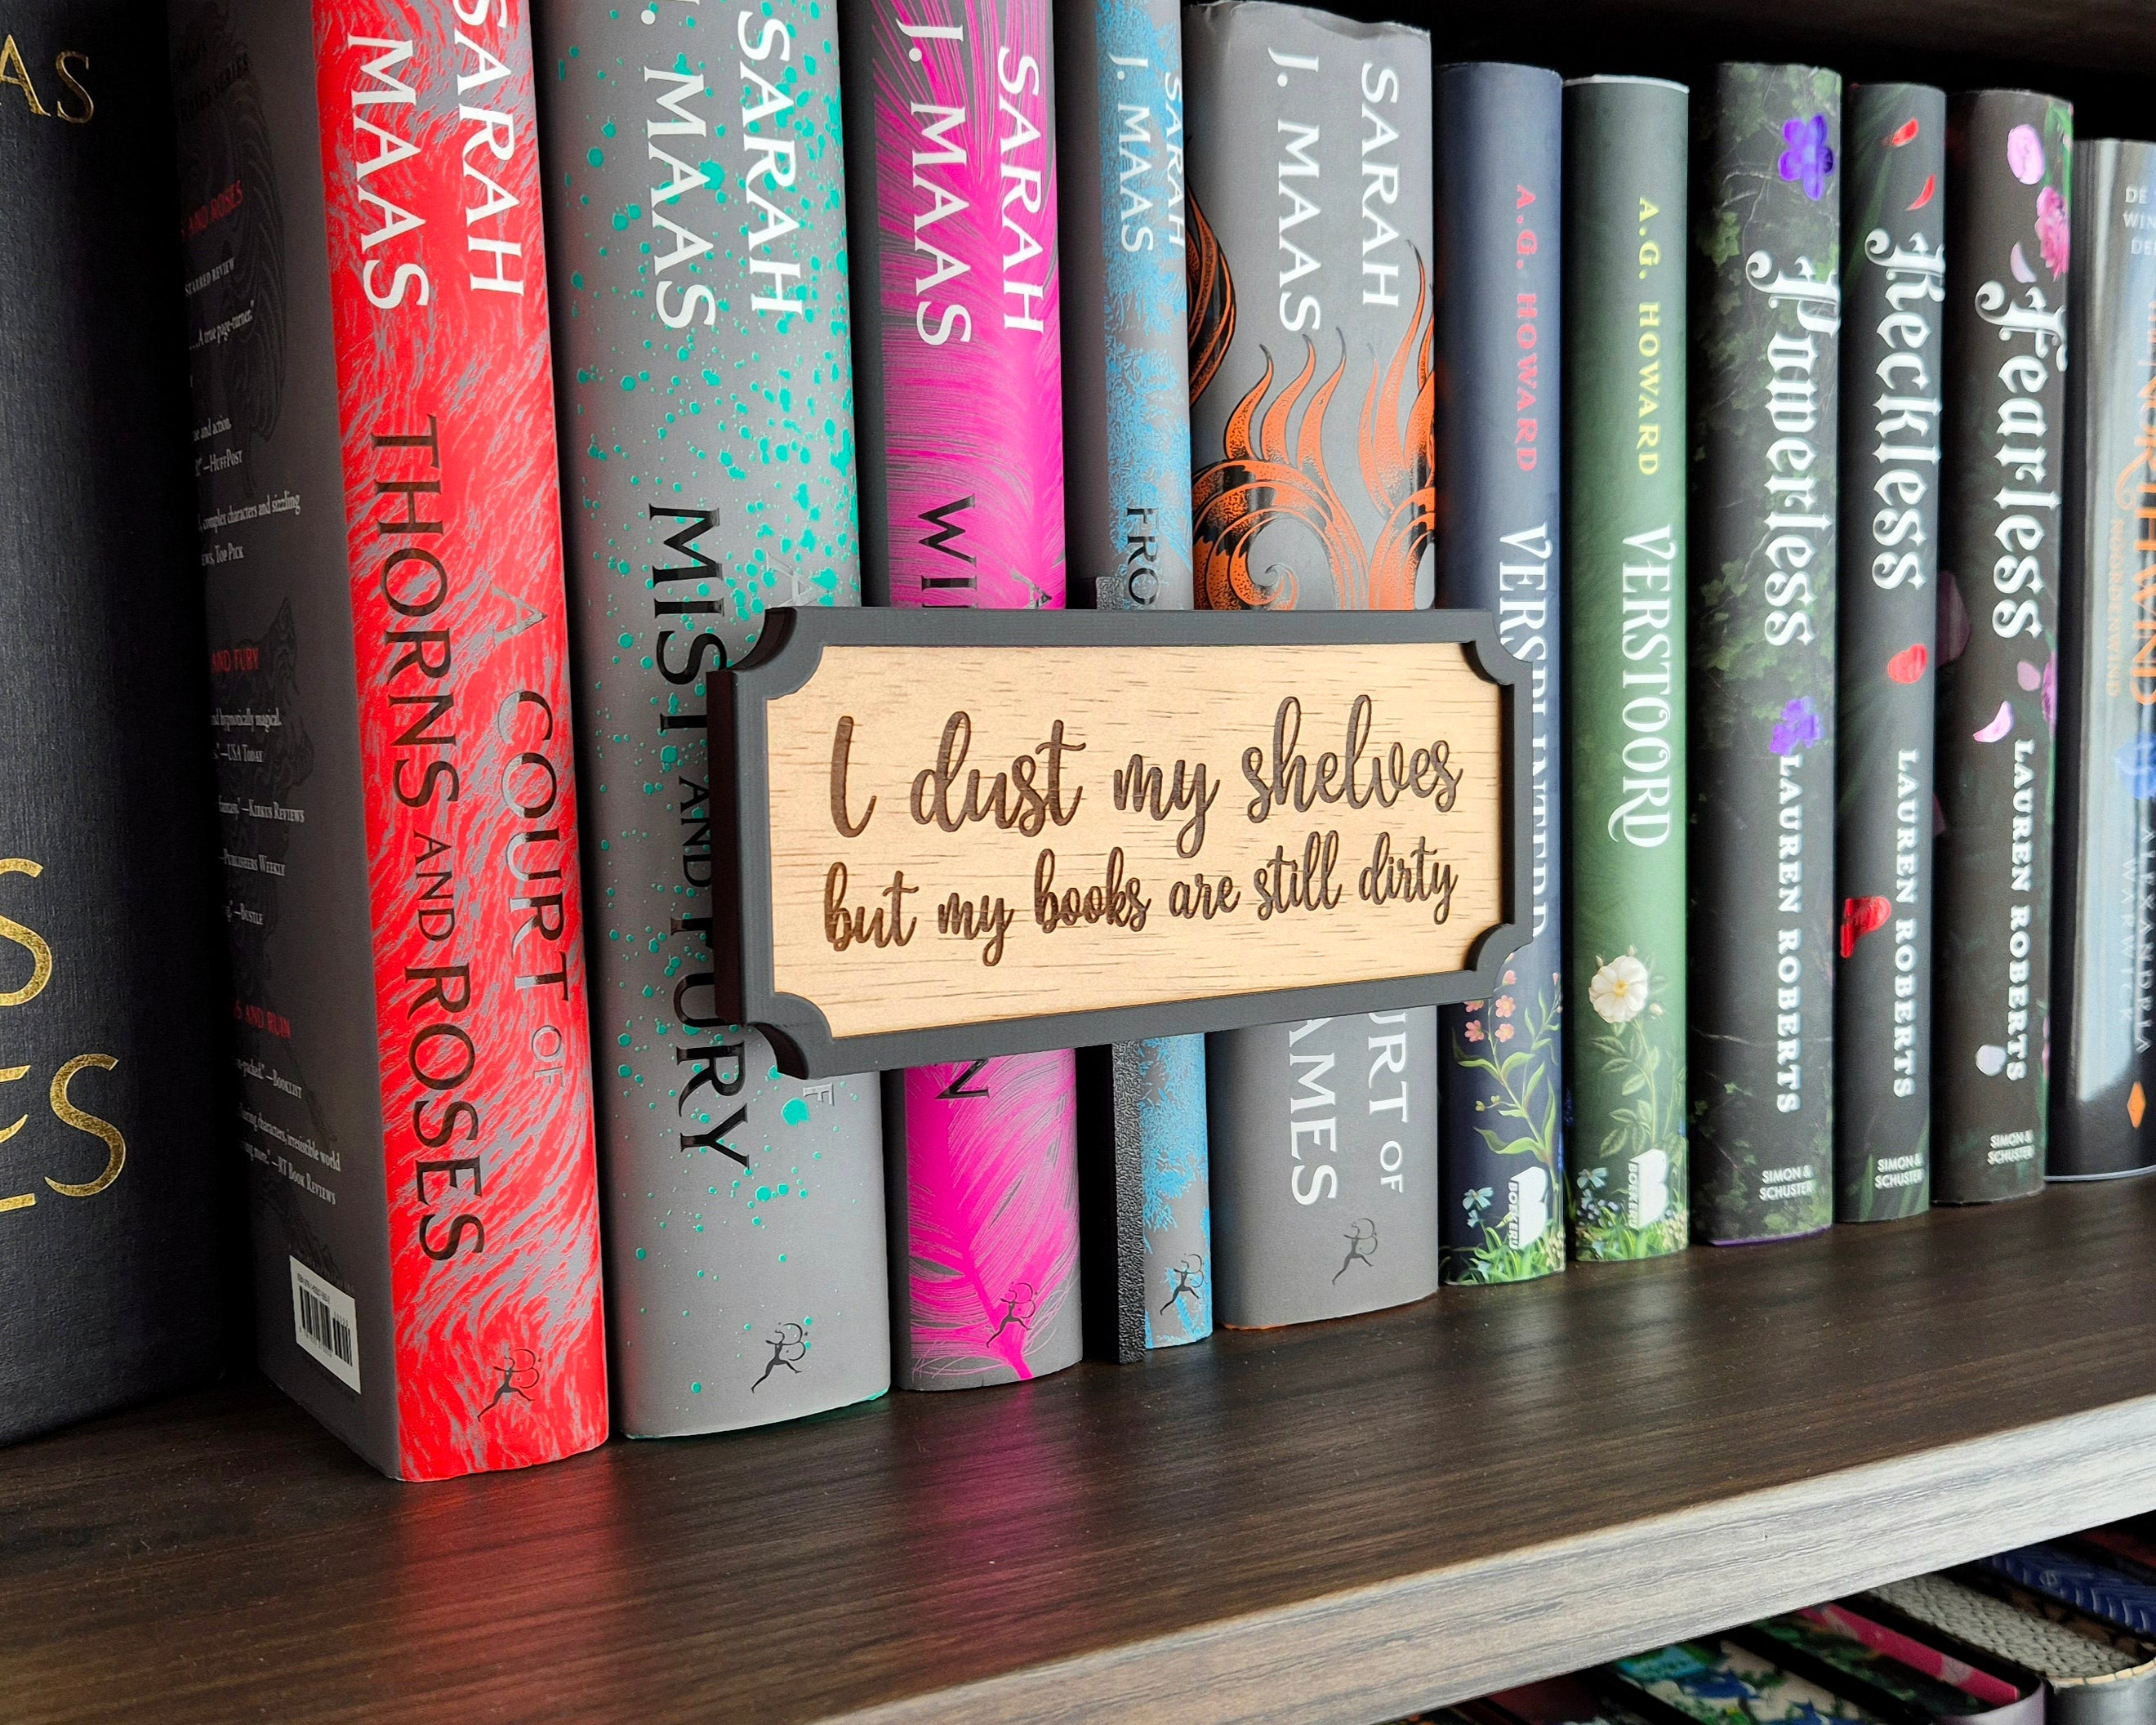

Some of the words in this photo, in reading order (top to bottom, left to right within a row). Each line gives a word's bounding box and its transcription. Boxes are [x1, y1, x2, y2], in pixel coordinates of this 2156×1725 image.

[895, 18, 964, 62] J.
[1108, 53, 1148, 80] J.
[1267, 47, 1319, 87] J.
[347, 33, 430, 309] MAAS
[453, 0, 524, 295] SARAH
[644, 66, 717, 328] MAAS
[737, 10, 804, 319] SARAH
[910, 100, 972, 346] MAAS
[998, 45, 1045, 334] SARAH
[1117, 103, 1154, 253] MAAS
[1165, 72, 1186, 250] SARAH
[1361, 61, 1400, 307] SARAH
[2125, 185, 2148, 204] DE
[1277, 119, 1321, 332] MAAS
[1517, 185, 1537, 269] A.G.
[1639, 196, 1660, 280] A.G.
[1515, 293, 1537, 471] HOWARD
[1636, 301, 1660, 475] HOWARD
[1745, 249, 1841, 647] Powerless
[1864, 228, 1945, 591] Reckless
[226, 505, 257, 525] characters
[258, 494, 272, 516] and
[271, 490, 301, 515] sizzling
[1975, 280, 2068, 640] Fearless
[234, 646, 260, 672] FURY
[371, 414, 460, 808] THORNS
[490, 585, 547, 648] A
[1607, 523, 1676, 849] VERSTOORD
[255, 706, 283, 733] magical
[831, 715, 877, 838] I
[910, 711, 1086, 837] dust
[1113, 753, 1220, 858] my
[1241, 694, 1463, 823] shelves
[413, 829, 456, 942] AND
[498, 690, 569, 1001] COURT
[1778, 753, 1803, 913] LAUREN
[1895, 748, 1919, 905] LAUREN
[2011, 739, 2035, 893] LAUREN
[824, 860, 920, 952] but
[938, 891, 1015, 967] my
[1034, 846, 1152, 934] books
[1169, 872, 1241, 920] are
[1254, 830, 1342, 921] still
[1358, 831, 1459, 925] dirty
[266, 1010, 292, 1039] RUIN
[531, 1025, 566, 1090] OF
[1776, 928, 1802, 1113] ROBERTS
[1893, 917, 1918, 1099] ROBERTS
[2006, 904, 2031, 1081] ROBERTS
[319, 1148, 342, 1172] world
[403, 965, 486, 1262] ROSES
[1379, 1140, 1404, 1194] OF
[1759, 1179, 1815, 1202] SCHUSTER
[1762, 1165, 1802, 1184] SIMON
[1802, 1164, 1813, 1179] &
[1874, 1168, 1926, 1190] SCHUSTER
[1877, 1155, 1913, 1173] SIMON
[1914, 1152, 1925, 1167] &
[1987, 1144, 2035, 1166] SCHUSTER
[1990, 1131, 2025, 1150] SIMON
